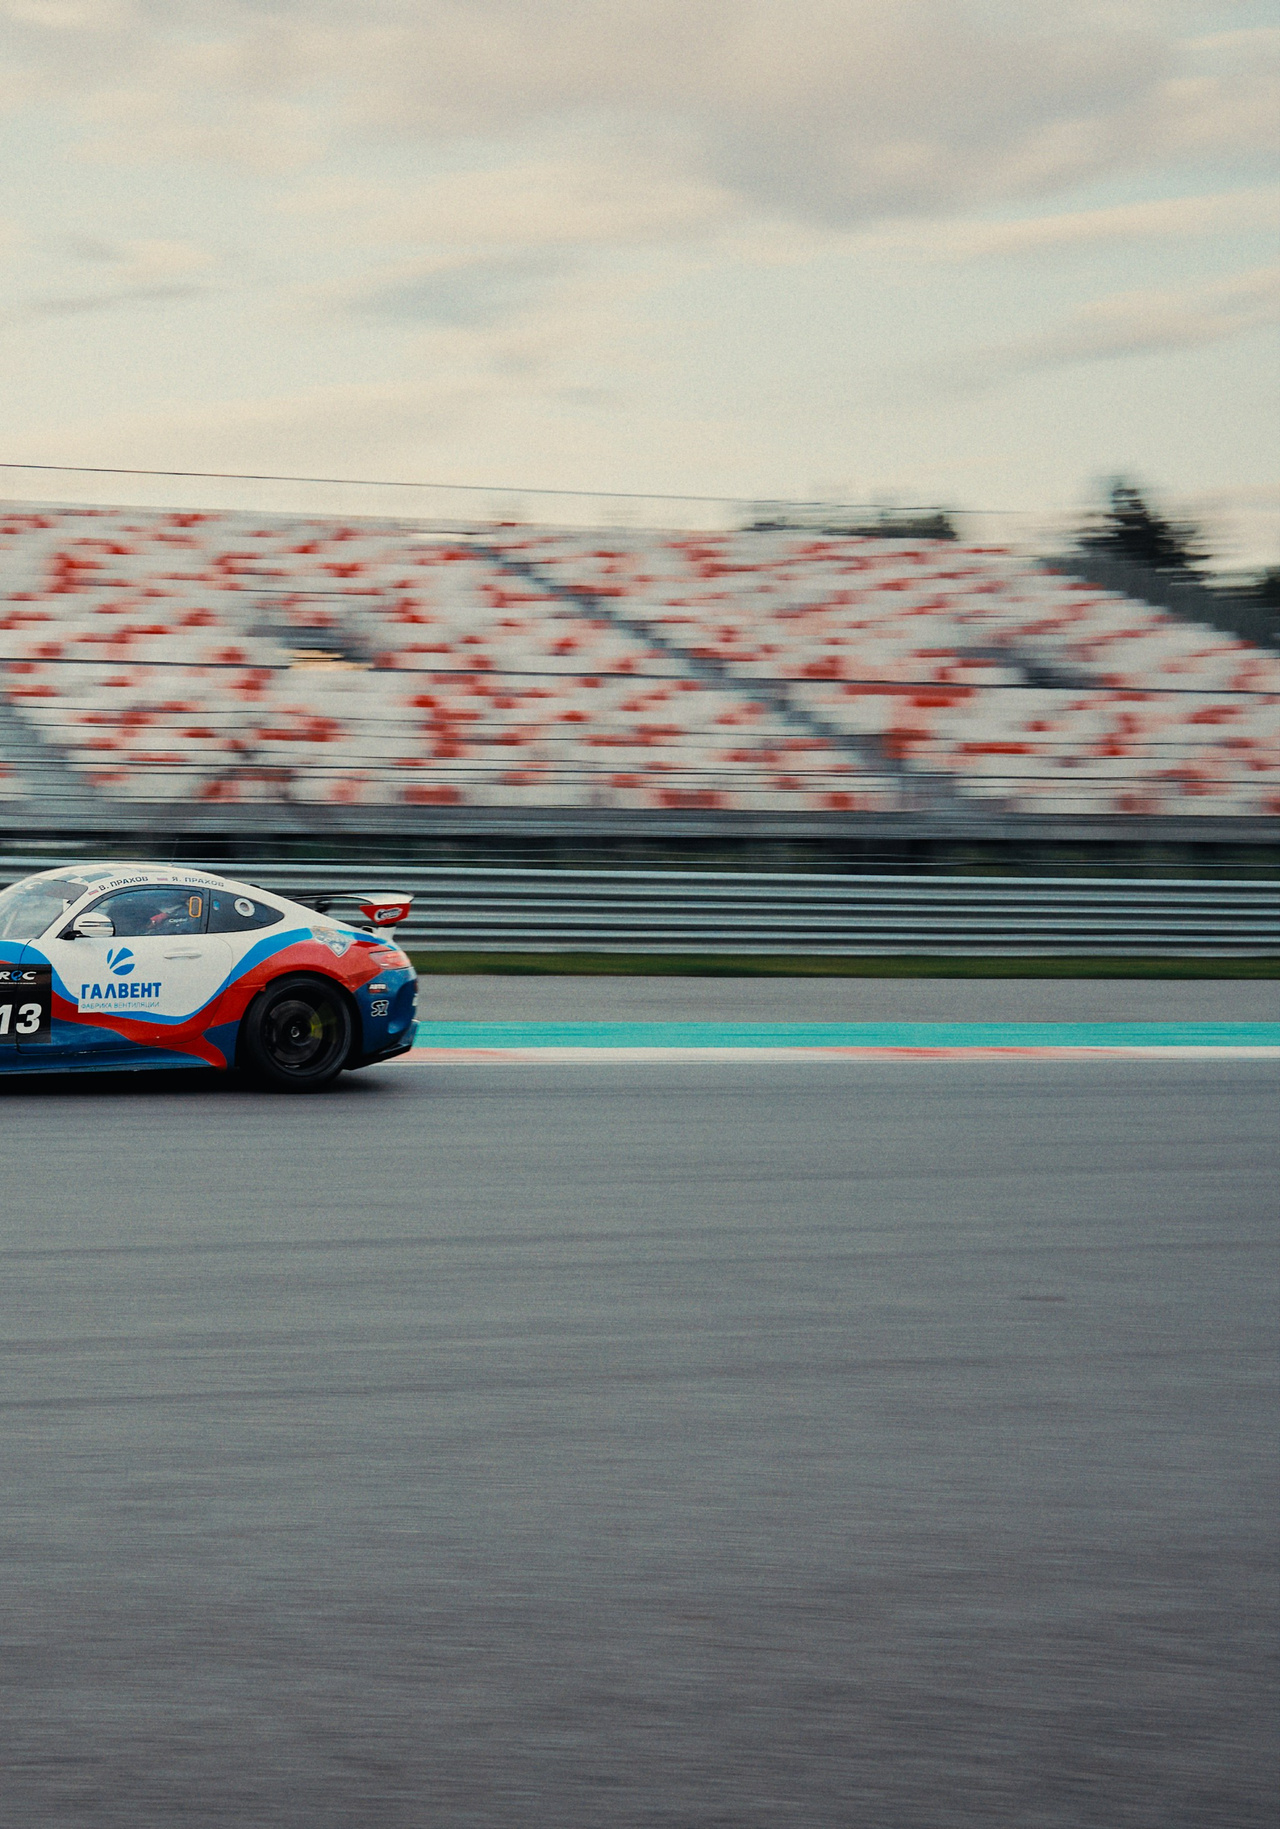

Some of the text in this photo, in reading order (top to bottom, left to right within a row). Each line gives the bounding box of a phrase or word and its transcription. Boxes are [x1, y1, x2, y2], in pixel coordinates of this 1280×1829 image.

[98, 876, 149, 891] В. ПРАХОВ
[184, 877, 225, 888] ПРАХОВ
[81, 982, 162, 999] ГАЛВЕНТ
[113, 1001, 160, 1009] ВЕНТИЛЯЦИИ
